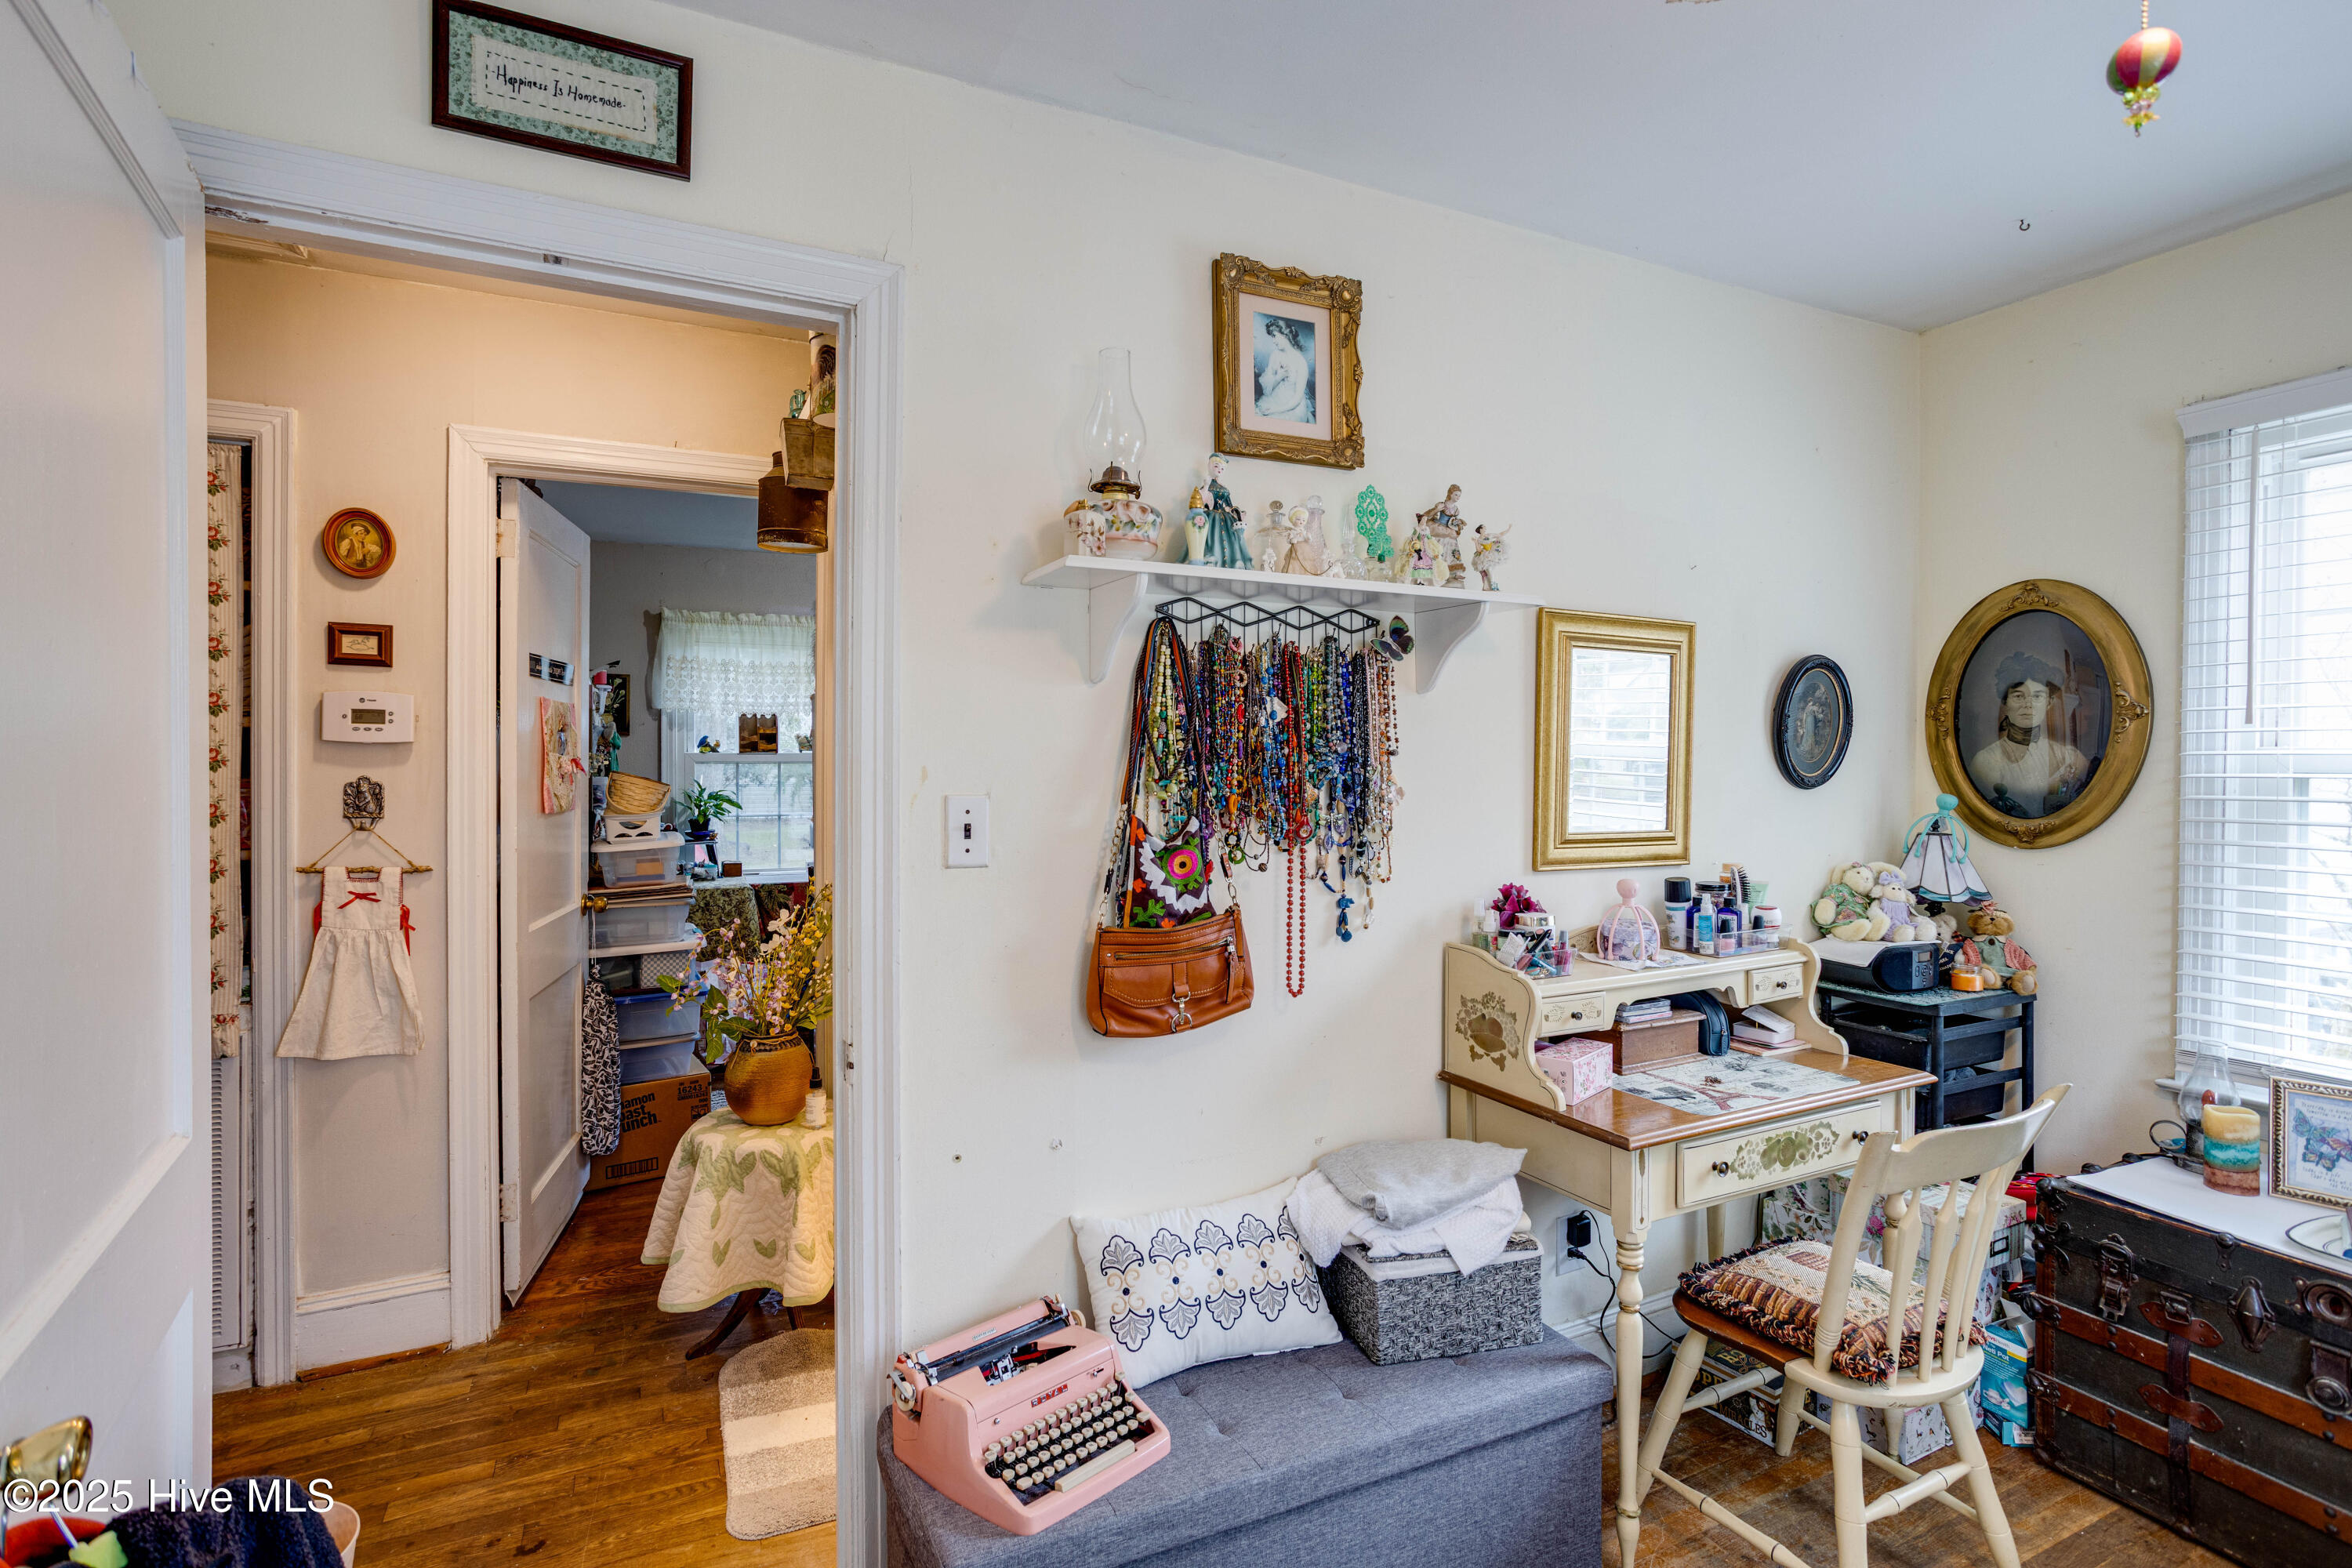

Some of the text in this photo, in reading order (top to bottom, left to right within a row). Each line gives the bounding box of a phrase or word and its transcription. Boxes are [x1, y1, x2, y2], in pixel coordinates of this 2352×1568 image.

[496, 64, 547, 94] Happiness
[552, 79, 564, 97] Is
[677, 1084, 702, 1094] 16243
[621, 1111, 658, 1133] unch
[1983, 1345, 1996, 1355] Neti
[1997, 1351, 2009, 1362] Pot
[1032, 1385, 1068, 1406] ROYAL
[1719, 1403, 1767, 1438] MIRACLES
